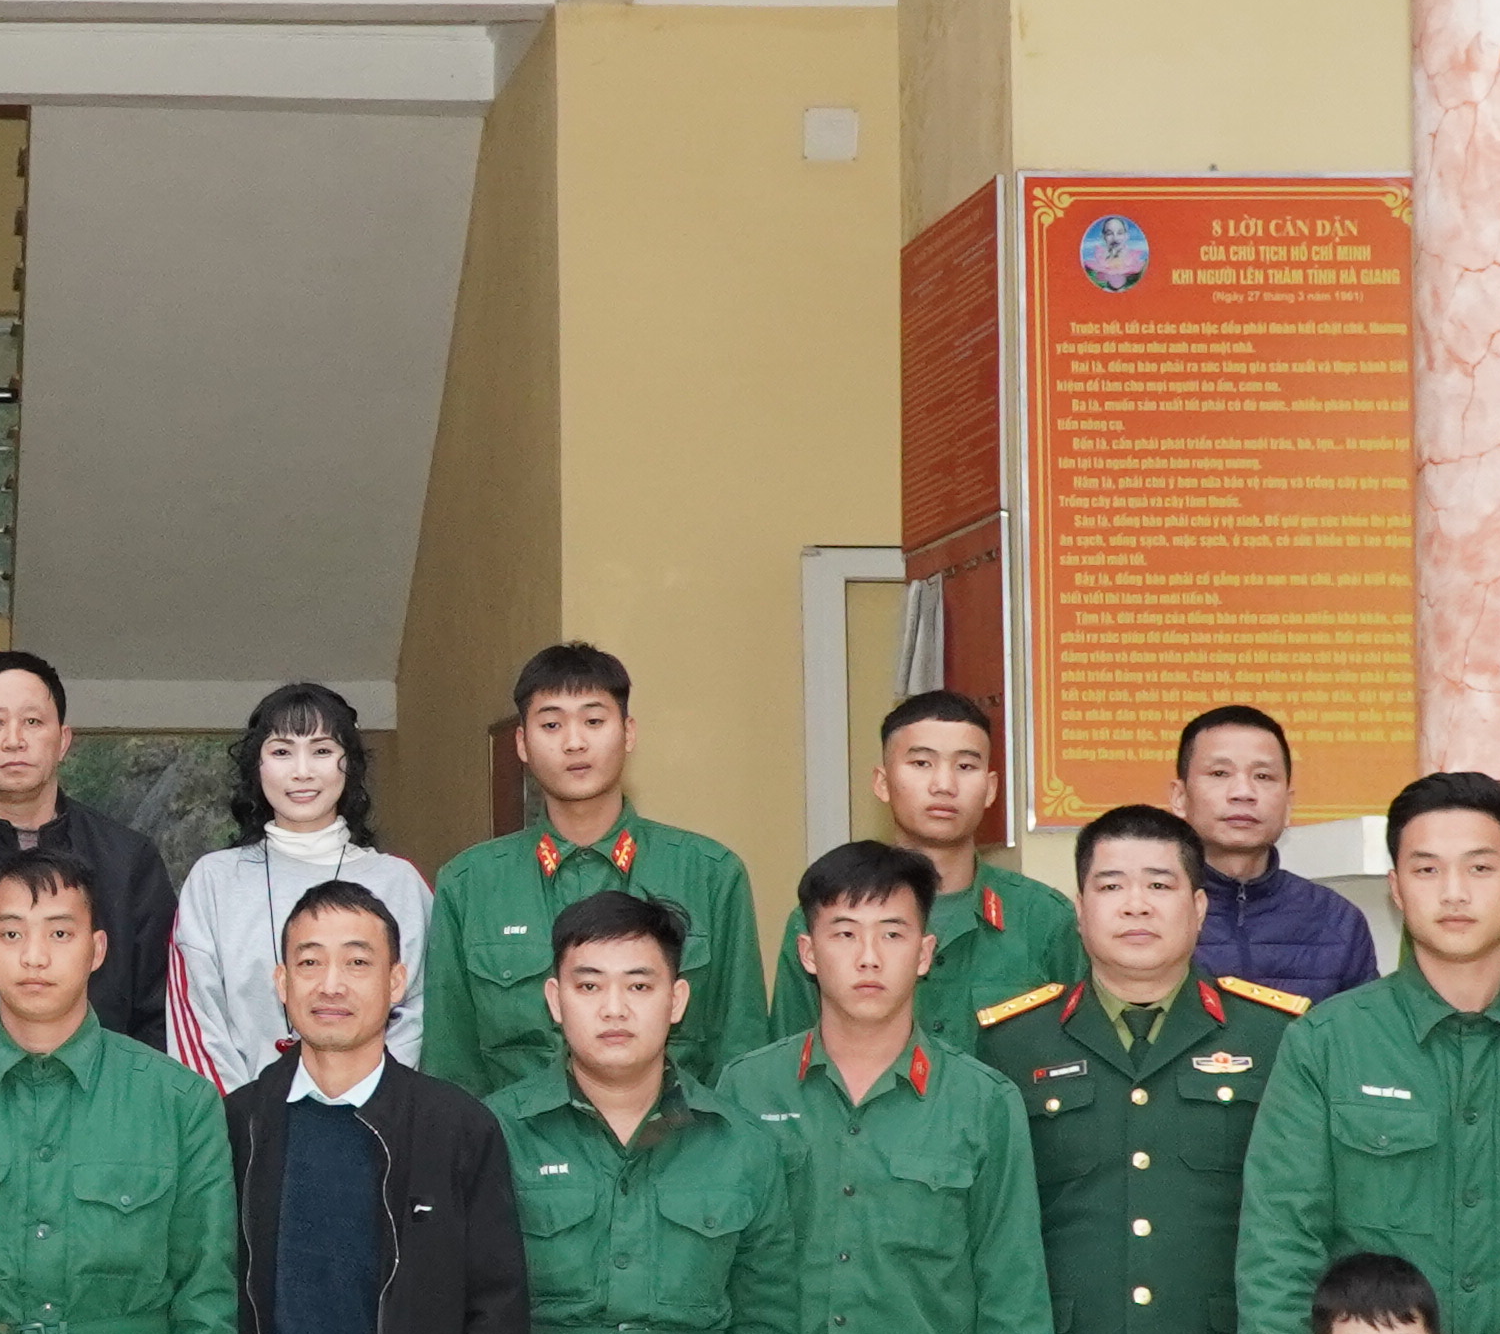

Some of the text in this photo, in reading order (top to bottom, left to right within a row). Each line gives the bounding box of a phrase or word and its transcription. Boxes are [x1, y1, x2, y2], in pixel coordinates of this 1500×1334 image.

[1212, 219, 1222, 237] 8
[1228, 214, 1263, 237] LỜI
[1200, 241, 1225, 261] CỦA
[1259, 245, 1287, 264] TỊCH
[1312, 243, 1332, 261] CHÍ
[1337, 245, 1371, 261] MINH
[1172, 269, 1193, 284] KHI
[1197, 266, 1236, 284] NGƯỜI
[1361, 269, 1400, 284] GIANG
[1248, 291, 1260, 301] 27
